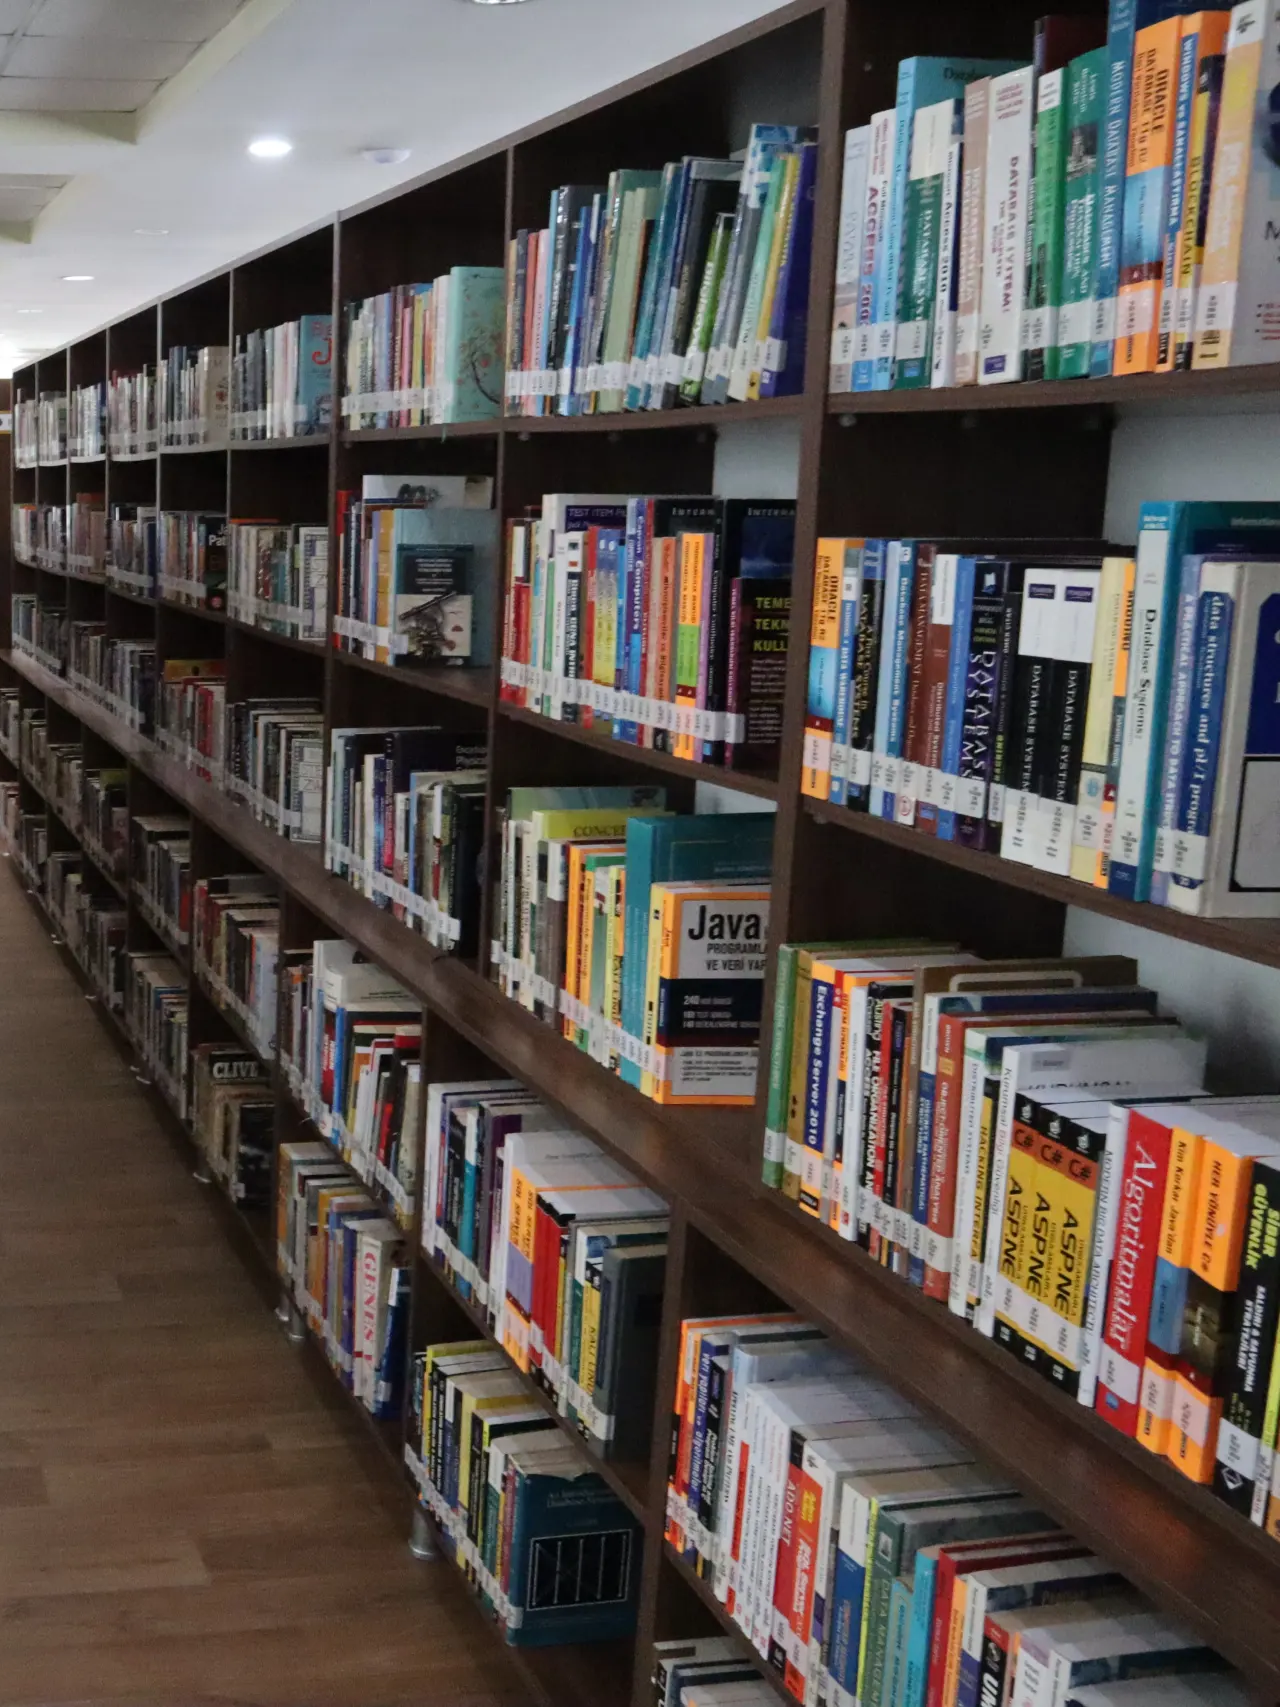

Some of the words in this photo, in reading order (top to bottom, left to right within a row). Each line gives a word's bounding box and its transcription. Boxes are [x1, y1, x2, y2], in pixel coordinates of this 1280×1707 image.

[1109, 61, 1125, 115] MODERN
[1141, 48, 1157, 116] DATABASE
[1179, 38, 1194, 102] WINDOWS
[1151, 69, 1170, 134] ORACLE
[1103, 118, 1122, 177] DATABASE
[1004, 155, 1020, 242] DATABASE
[1180, 157, 1202, 276] BLOCKCHAIN
[941, 201, 953, 252] Access
[1099, 184, 1119, 270] MANAGEMENT
[939, 256, 950, 293] 2010
[1079, 271, 1089, 294] AND
[568, 508, 589, 517] TEST
[636, 515, 645, 554] Capron
[632, 559, 644, 630] Computers
[820, 555, 831, 607] DATABASE
[826, 575, 839, 624] ORACLE
[897, 577, 908, 627] Database
[916, 571, 929, 600] DATA
[1184, 593, 1195, 603] A
[856, 594, 869, 671] DATABASE
[1178, 606, 1195, 667] PRACTICAL
[1210, 595, 1225, 630] data
[840, 647, 850, 670] DATA
[864, 634, 873, 659] First
[892, 630, 905, 695] Management
[912, 602, 927, 677] MANAGEMENT
[1141, 608, 1157, 674] Database
[861, 661, 871, 698] Course
[1200, 635, 1219, 710] structures
[837, 672, 849, 729] WAREHOUSE
[851, 674, 864, 738] SYSTEMS
[888, 699, 901, 743] Systems
[933, 681, 945, 732] Distributed
[961, 652, 982, 780] SYSTEMS
[1027, 665, 1043, 734] DATABASE
[1061, 670, 1078, 742] DATABASE
[1172, 671, 1190, 737] APPROACH
[1170, 738, 1184, 756] TO
[1196, 713, 1212, 743] and
[1167, 758, 1181, 790] DATA
[687, 905, 761, 941] Java
[705, 959, 719, 971] VE
[722, 957, 745, 971] VERİ
[813, 985, 828, 1057] Exchange
[871, 999, 884, 1041] Austing
[810, 1059, 824, 1106] Server
[872, 1049, 881, 1075] FILE
[967, 1063, 979, 1128] DISTRIBUTED
[999, 1067, 1013, 1127] Kurumsal
[808, 1108, 819, 1144] 2010
[865, 1077, 880, 1170] ORGANIZATION
[934, 1081, 950, 1174] OBJECT-ORIENTED
[996, 1129, 1007, 1156] Bilgi
[1014, 1128, 1034, 1149] C#
[963, 1130, 973, 1175] SYSTEMS
[976, 1125, 989, 1190] HACKING
[1039, 1144, 1062, 1166] C#
[1067, 1158, 1091, 1181] C#
[1100, 1150, 1114, 1200] MODERN
[1176, 1140, 1188, 1162] Kim
[1211, 1160, 1223, 1187] HER
[515, 1178, 523, 1198] SQL
[526, 1189, 534, 1210] SQL
[931, 1174, 944, 1224] ANALYSIS
[991, 1158, 1005, 1216] Güvenliği
[1170, 1163, 1185, 1203] Korkar
[513, 1203, 522, 1245] SERVER
[524, 1215, 533, 1257] SERVER
[1096, 1206, 1107, 1226] BIG
[1165, 1205, 1180, 1255] Java'dan
[1201, 1191, 1219, 1251] YÖNÜYLE
[1245, 1182, 1267, 1270] GÜVENLİK
[1263, 1208, 1280, 1259] SİBER
[1092, 1228, 1105, 1258] DATA
[1109, 1143, 1158, 1351] Algoritmalar
[1200, 1253, 1212, 1272] C#
[1253, 1286, 1267, 1330] SALDIRI
[587, 1326, 596, 1357] KALI
[1237, 1300, 1254, 1371] STRATEJİLERİ
[701, 1353, 710, 1371] veri
[1243, 1343, 1259, 1395] SAVUNMA
[697, 1373, 709, 1413] yapıları
[690, 1431, 704, 1491] algoritmalar
[705, 1428, 713, 1458] Program
[709, 1433, 717, 1464] Problem
[878, 1579, 890, 1618] DATA
